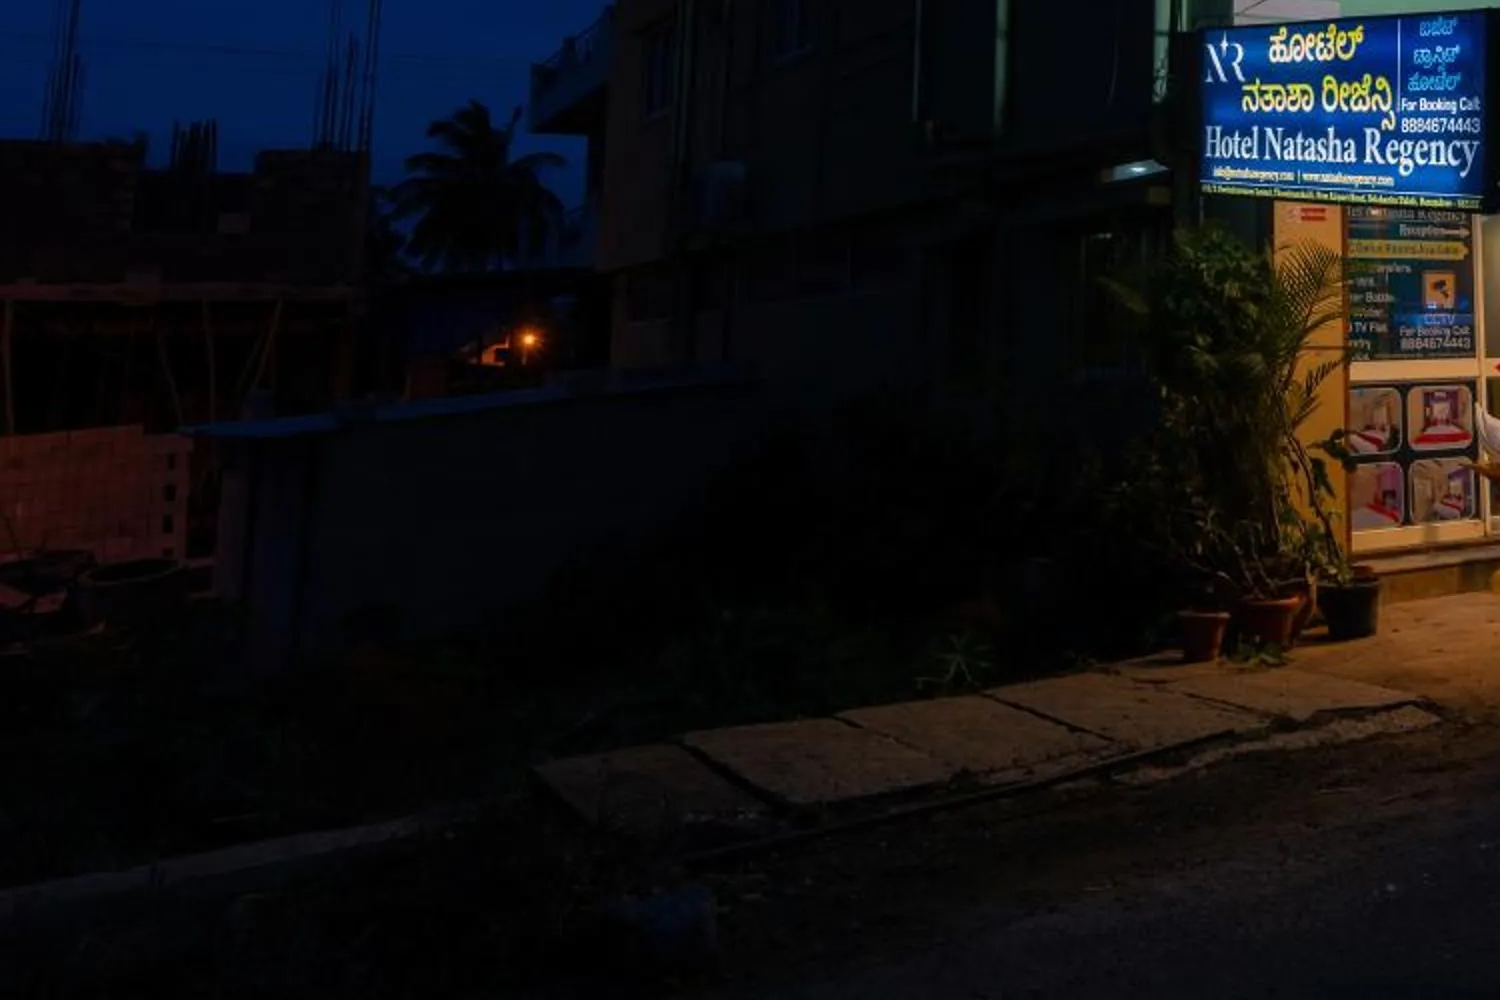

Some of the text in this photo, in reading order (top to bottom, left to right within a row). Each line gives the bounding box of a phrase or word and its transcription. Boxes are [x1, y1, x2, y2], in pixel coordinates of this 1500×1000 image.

[1269, 23, 1364, 63] ಹೋಟೆಲ್
[1401, 97, 1418, 111] For
[1419, 97, 1457, 115] Booking
[1205, 124, 1480, 178] Hotel Natasha Regency
